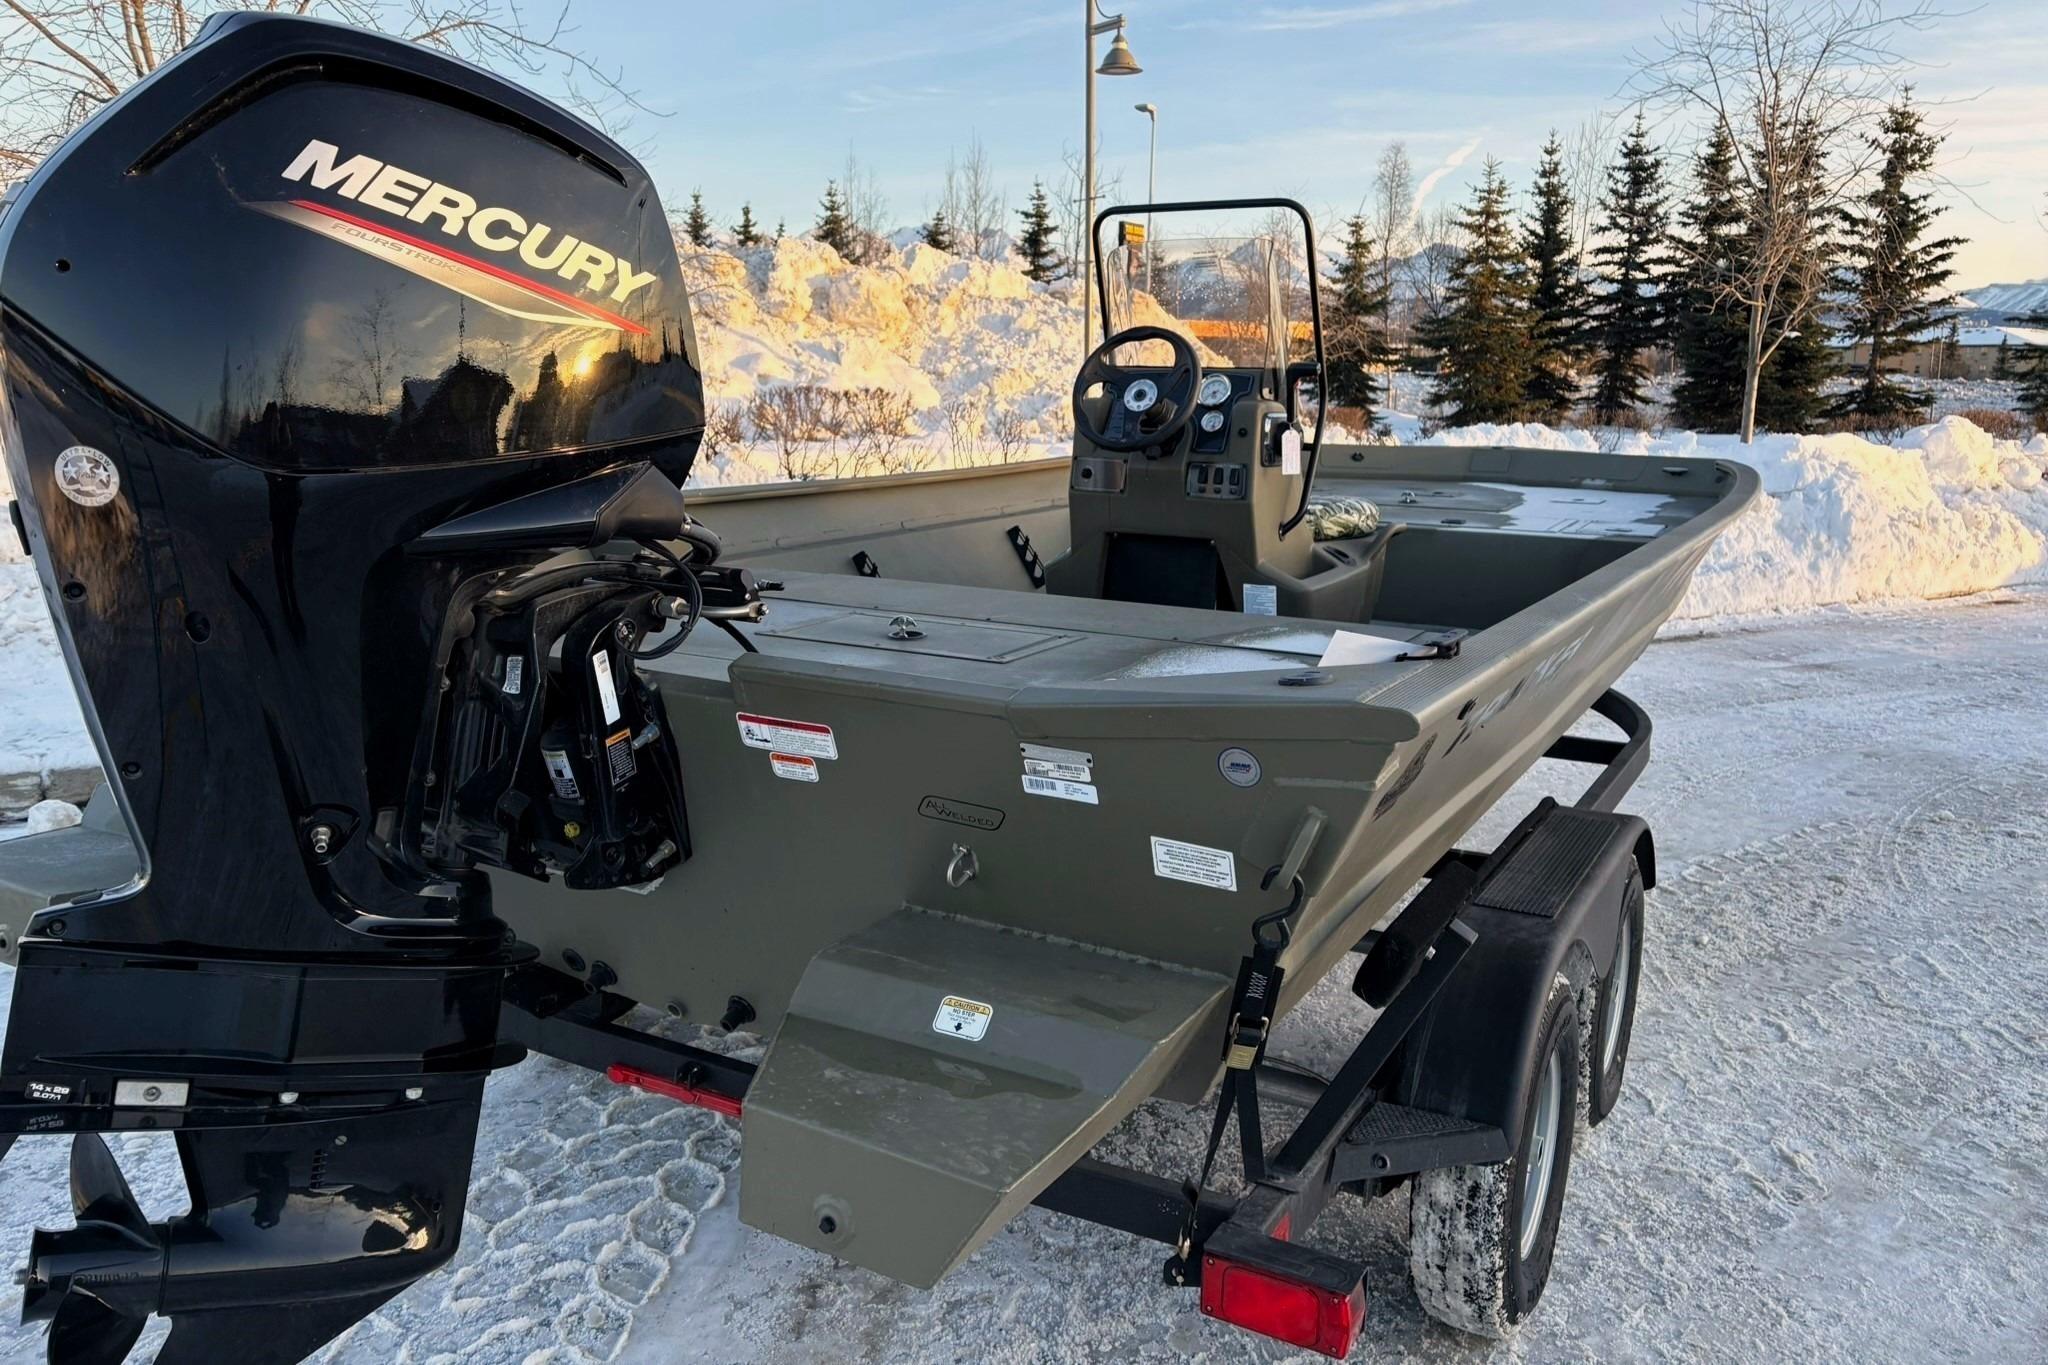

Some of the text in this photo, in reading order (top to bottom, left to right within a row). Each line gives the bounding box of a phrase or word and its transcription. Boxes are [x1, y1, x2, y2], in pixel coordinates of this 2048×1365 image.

[281, 138, 656, 303] MERCURY
[331, 222, 469, 275] FOURSTROKE
[93, 450, 112, 467] LOW
[953, 1001, 980, 1011] CAUTION
[30, 1083, 43, 1091] 14
